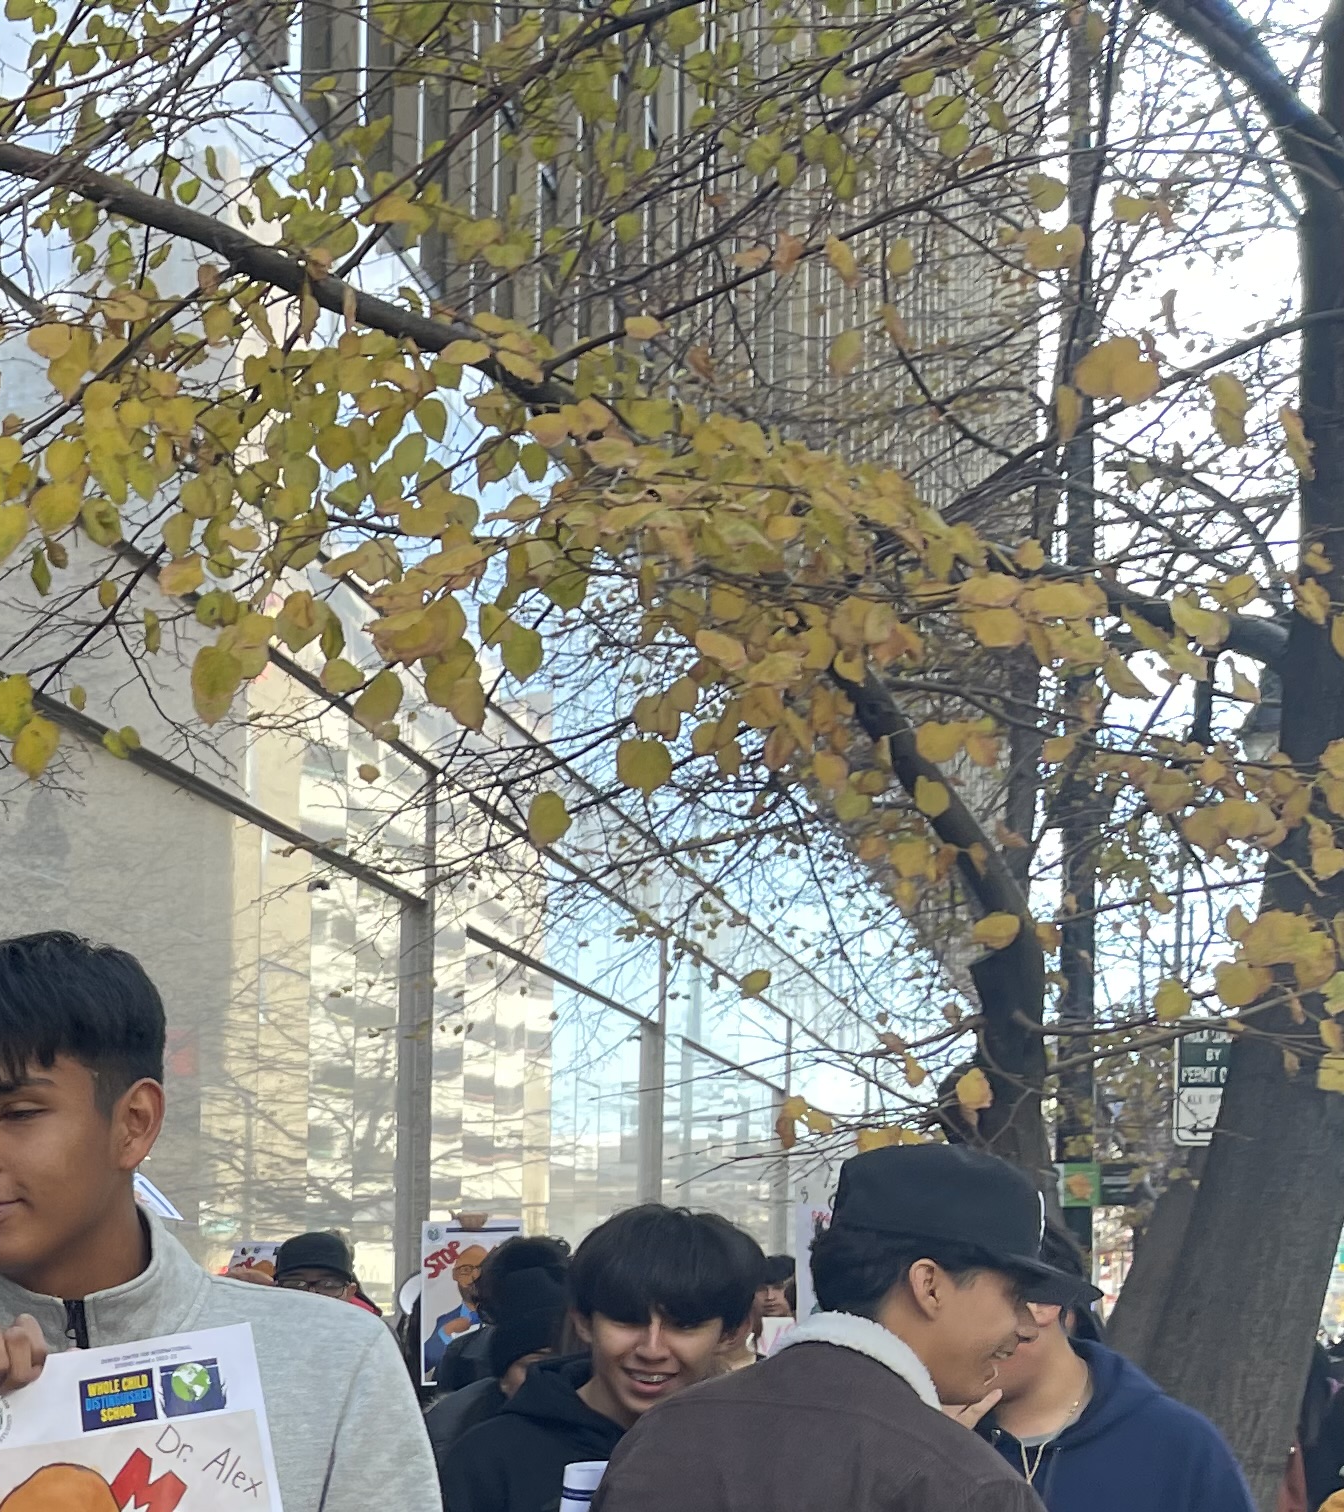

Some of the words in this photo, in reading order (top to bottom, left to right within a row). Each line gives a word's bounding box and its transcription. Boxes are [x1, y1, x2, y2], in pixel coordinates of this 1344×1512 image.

[1205, 1048, 1222, 1062] BY
[1181, 1066, 1218, 1083] PERMIT
[424, 1240, 461, 1279] STOP
[86, 1379, 121, 1398] WHOLE
[121, 1374, 149, 1392] CHILD
[100, 1404, 138, 1423] SCHOOL
[155, 1424, 194, 1463] Dr.
[202, 1447, 264, 1499] Alex
